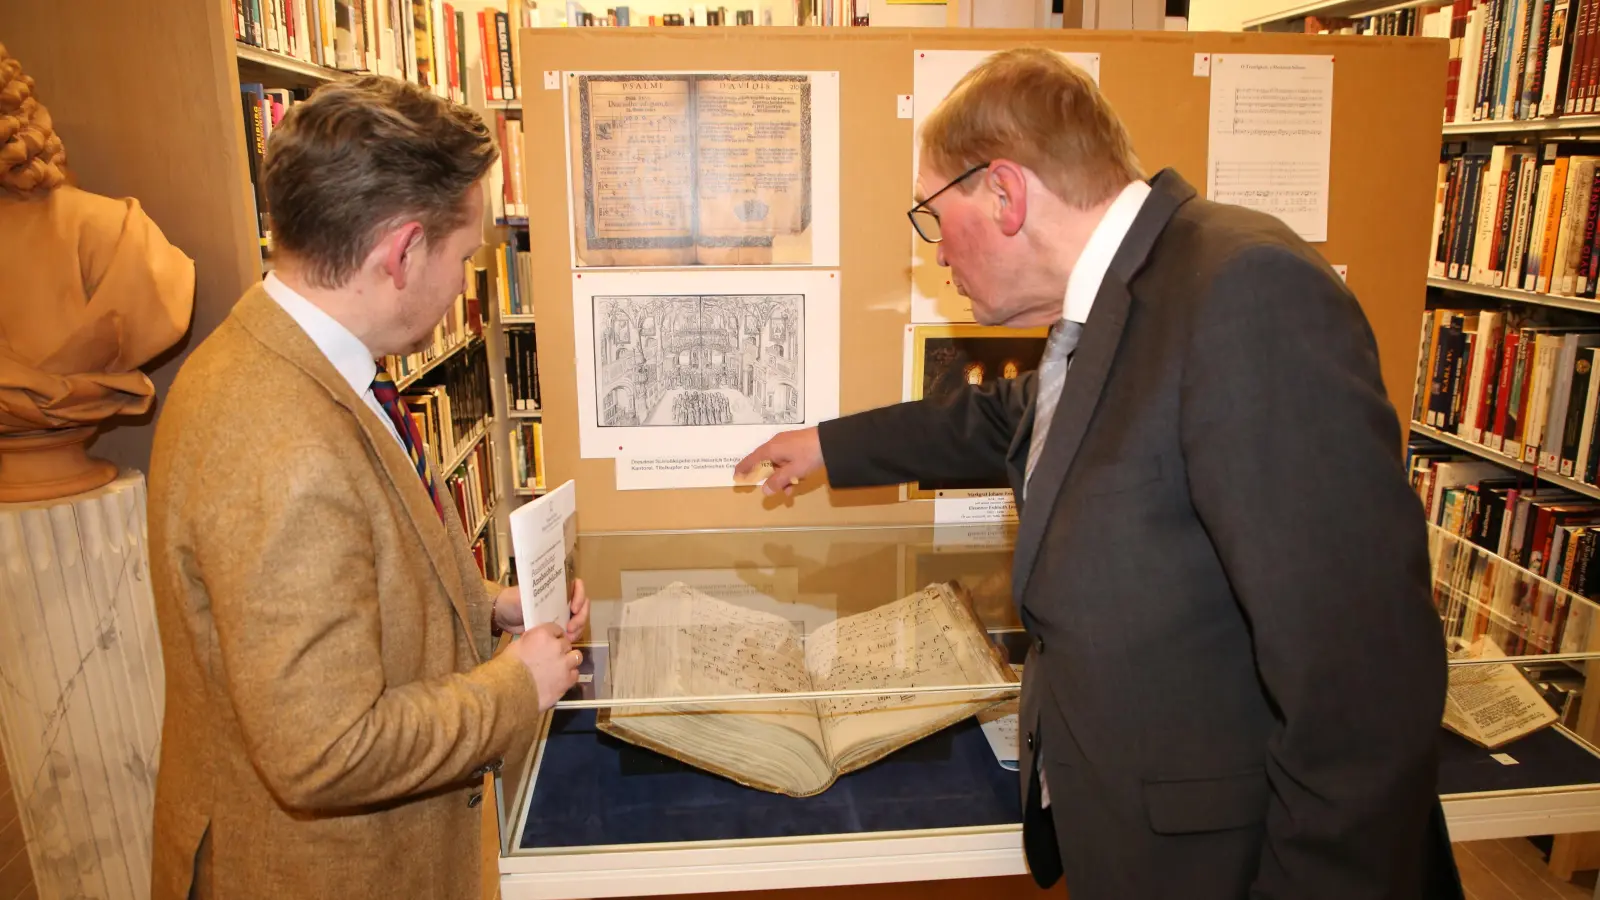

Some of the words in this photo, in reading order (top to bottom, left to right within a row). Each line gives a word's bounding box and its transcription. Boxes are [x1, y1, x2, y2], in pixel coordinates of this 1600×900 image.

[622, 82, 663, 90] PSALMI
[720, 82, 770, 90] DAVIDIS
[254, 106, 262, 154] FREIBURG
[1508, 171, 1516, 191] SAN
[1502, 193, 1512, 231] MARCO
[1580, 245, 1591, 276] AVID
[1586, 176, 1600, 240] HOCKNEY
[533, 564, 555, 588] Ansbacher
